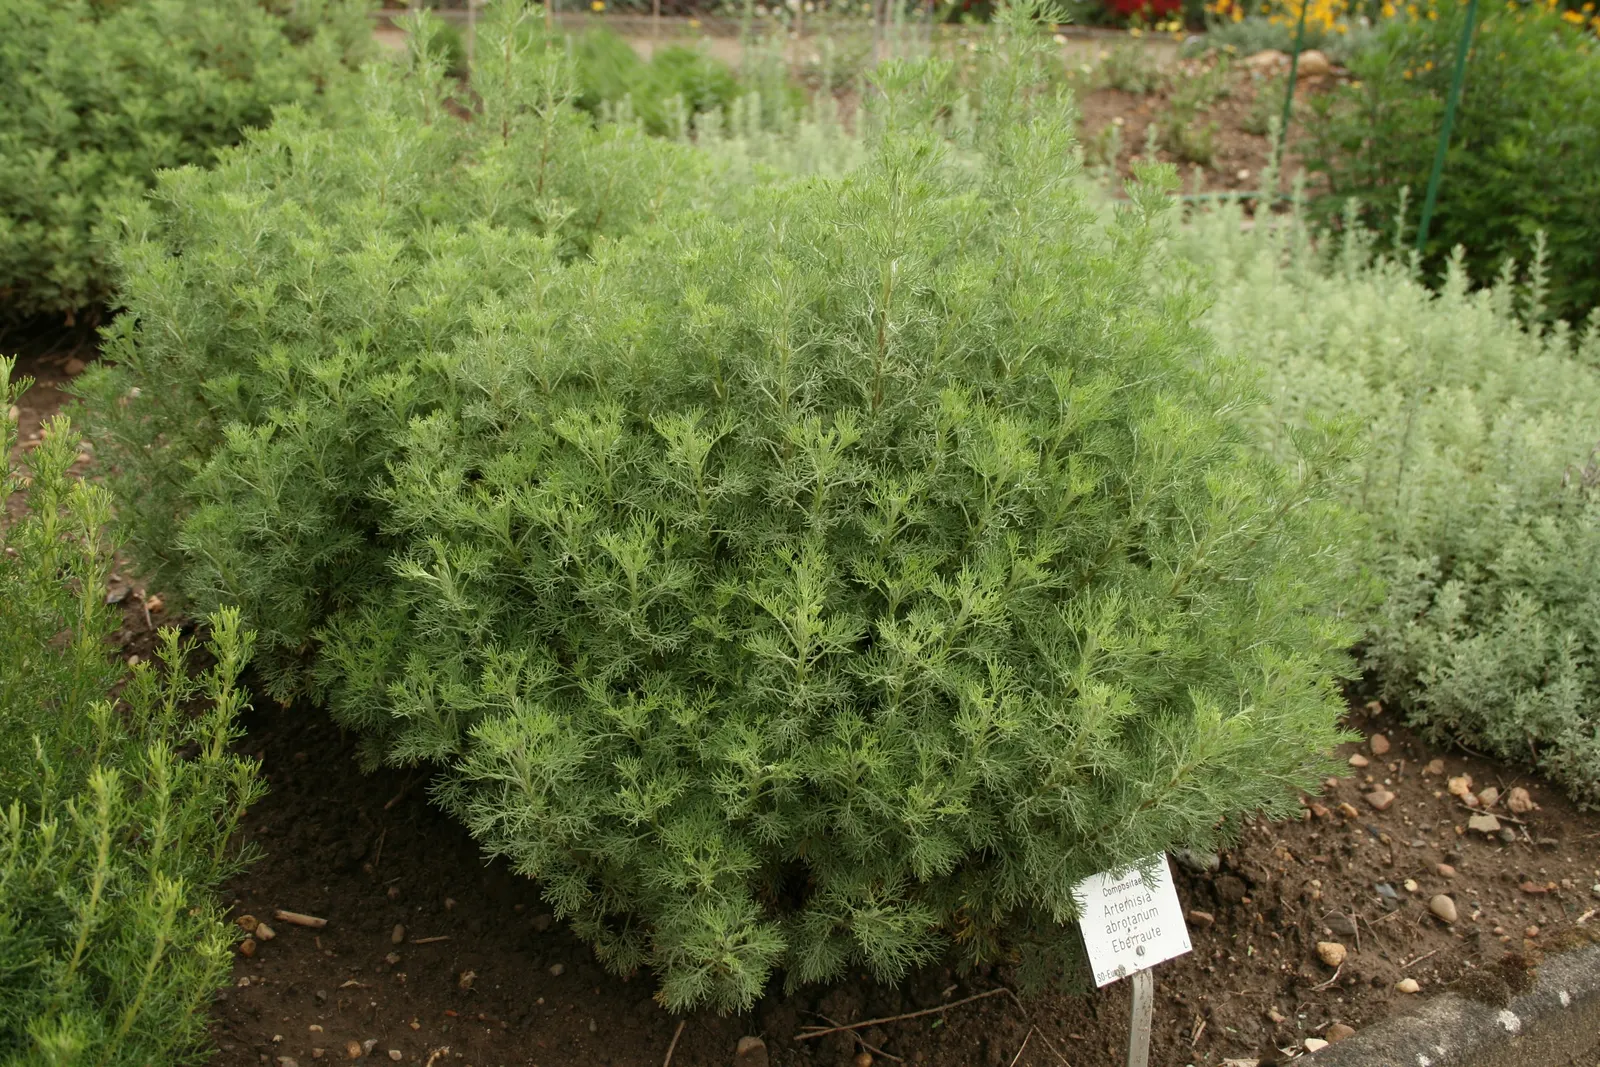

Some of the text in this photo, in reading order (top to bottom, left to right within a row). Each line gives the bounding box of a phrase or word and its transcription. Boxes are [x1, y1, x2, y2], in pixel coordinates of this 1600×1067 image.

[1102, 877, 1142, 897] Compositae
[1104, 892, 1152, 918] Artemisia
[1105, 907, 1159, 935] abrotanum
[1112, 927, 1162, 953] Eberraute
